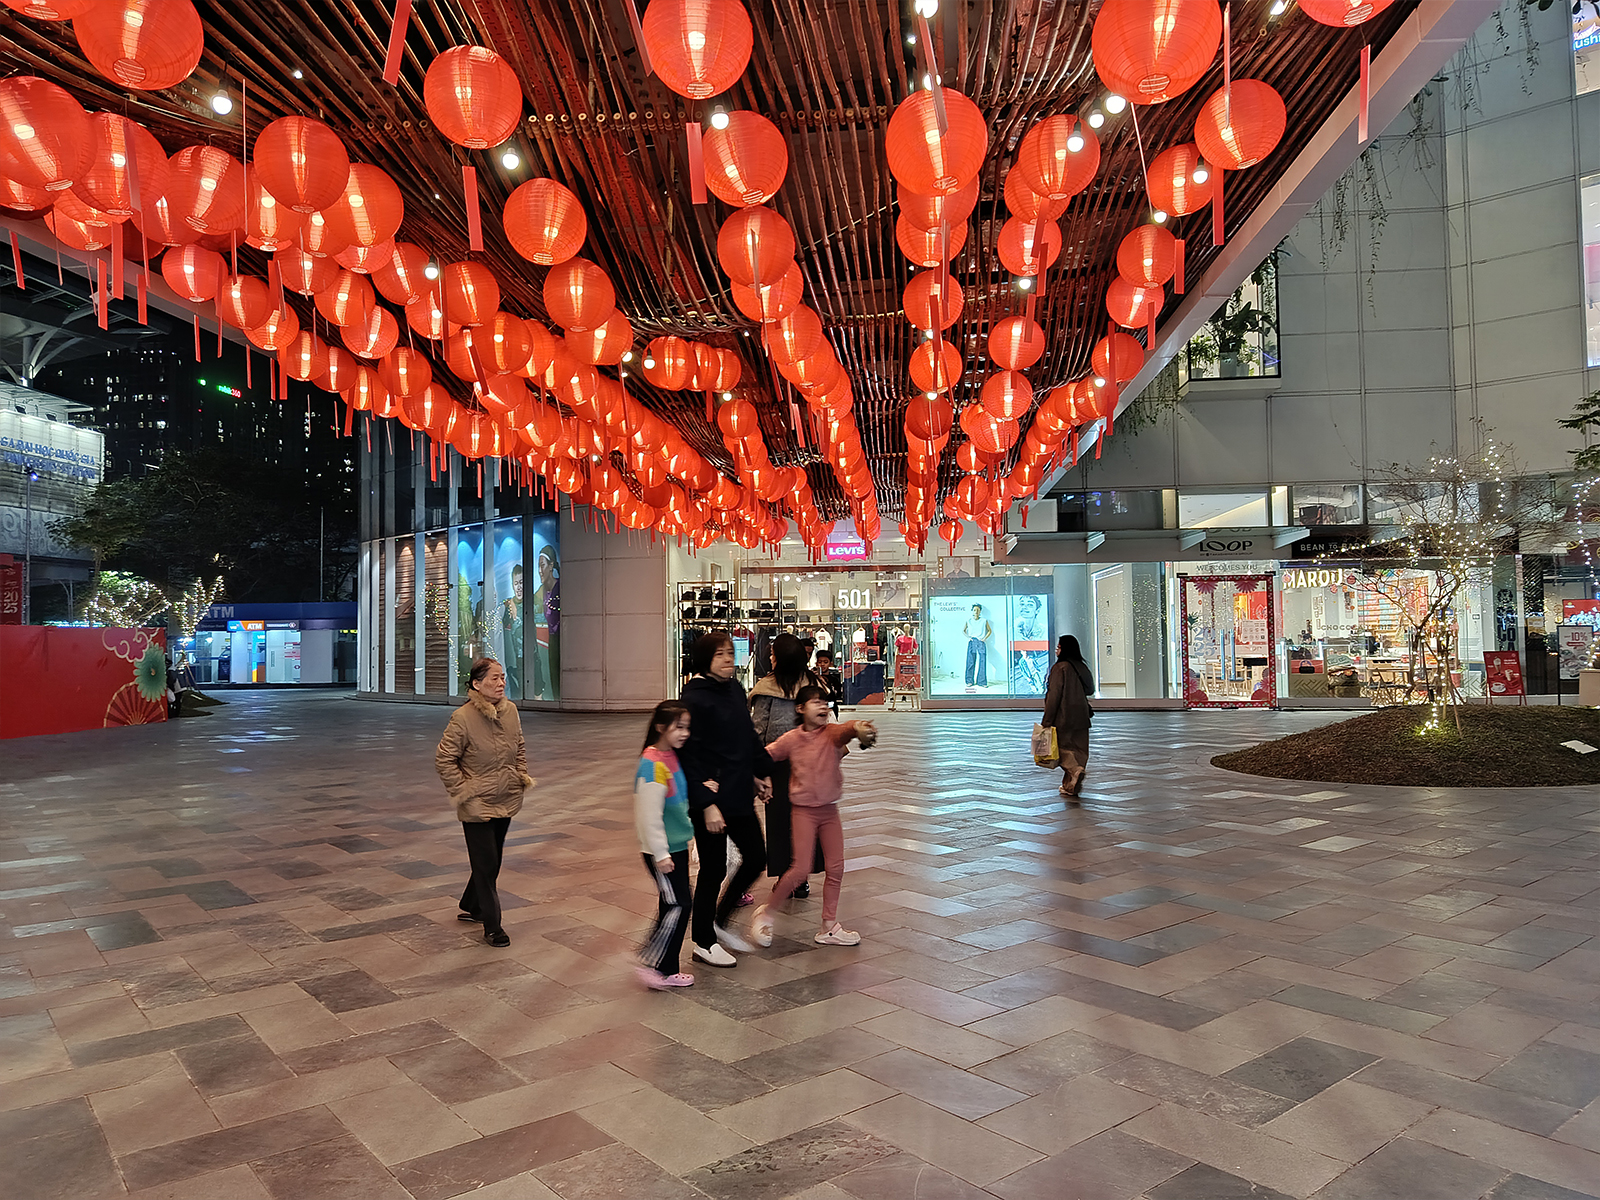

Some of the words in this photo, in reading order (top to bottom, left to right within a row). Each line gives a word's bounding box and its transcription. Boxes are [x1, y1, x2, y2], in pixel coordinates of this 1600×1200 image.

[1200, 540, 1253, 552] LOOP
[1300, 543, 1325, 551] BEAN
[1282, 569, 1343, 590] MAROU
[4, 591, 19, 602] 20
[838, 588, 871, 609] 501
[4, 603, 18, 614] 25
